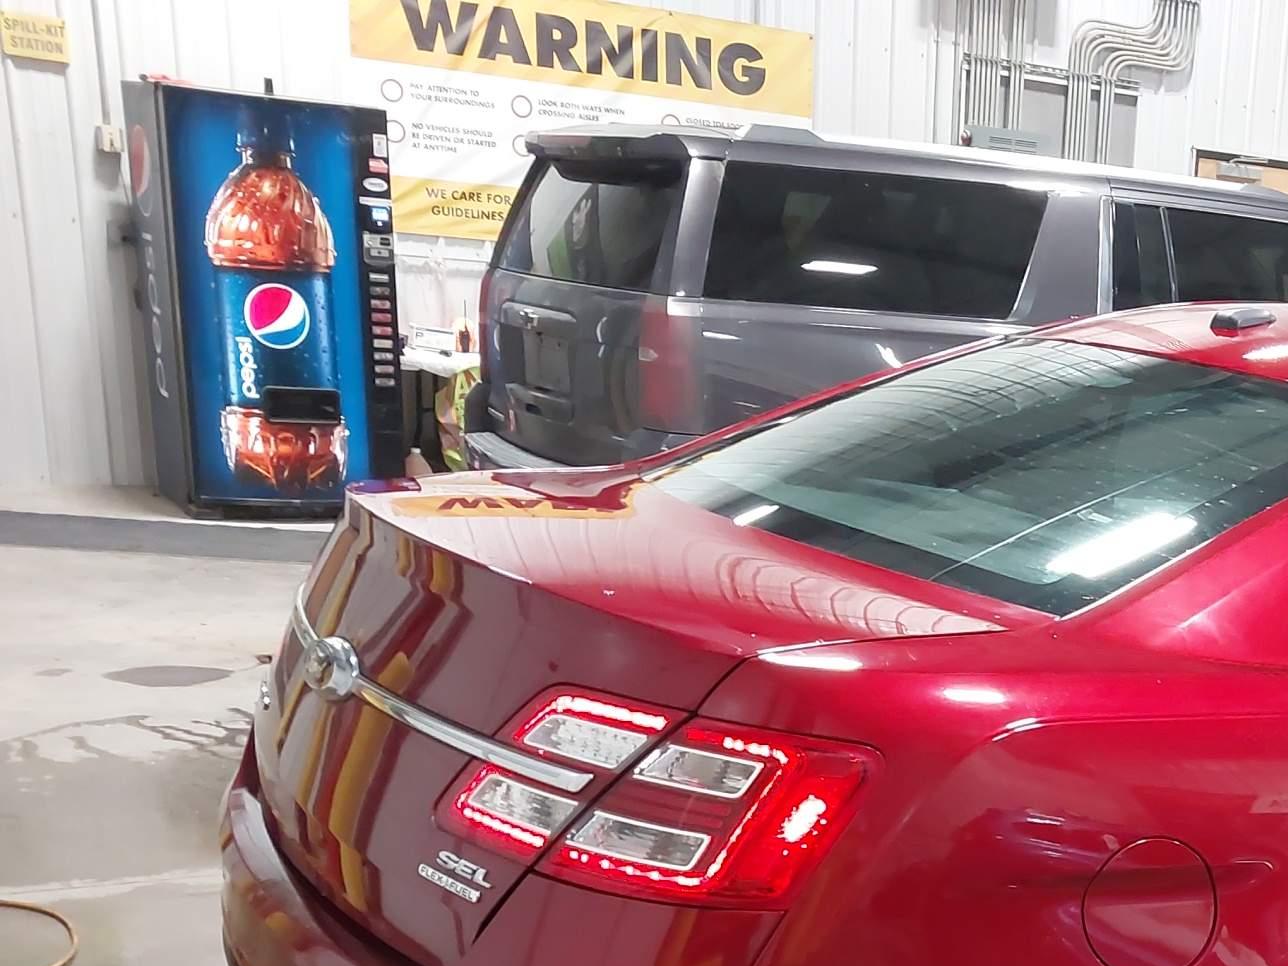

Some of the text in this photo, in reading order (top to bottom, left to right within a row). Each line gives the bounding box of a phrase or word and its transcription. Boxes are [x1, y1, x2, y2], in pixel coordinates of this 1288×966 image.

[3, 17, 65, 38] SPILL-KIT
[10, 35, 64, 54] STATION
[404, 0, 767, 96] WARNING
[428, 85, 467, 96] ATTENTION
[410, 93, 495, 109] YOUR SURROUNDINGS
[411, 122, 493, 138] NO VEHICLES SHOULD
[422, 134, 451, 143] DRIVEN
[467, 138, 497, 148] STARTED
[423, 143, 457, 153] ANYTIME
[425, 187, 513, 207] WE CARE FOR
[431, 205, 504, 221] GUIDELINES
[235, 336, 260, 398] pepsi
[436, 850, 492, 888] SEL
